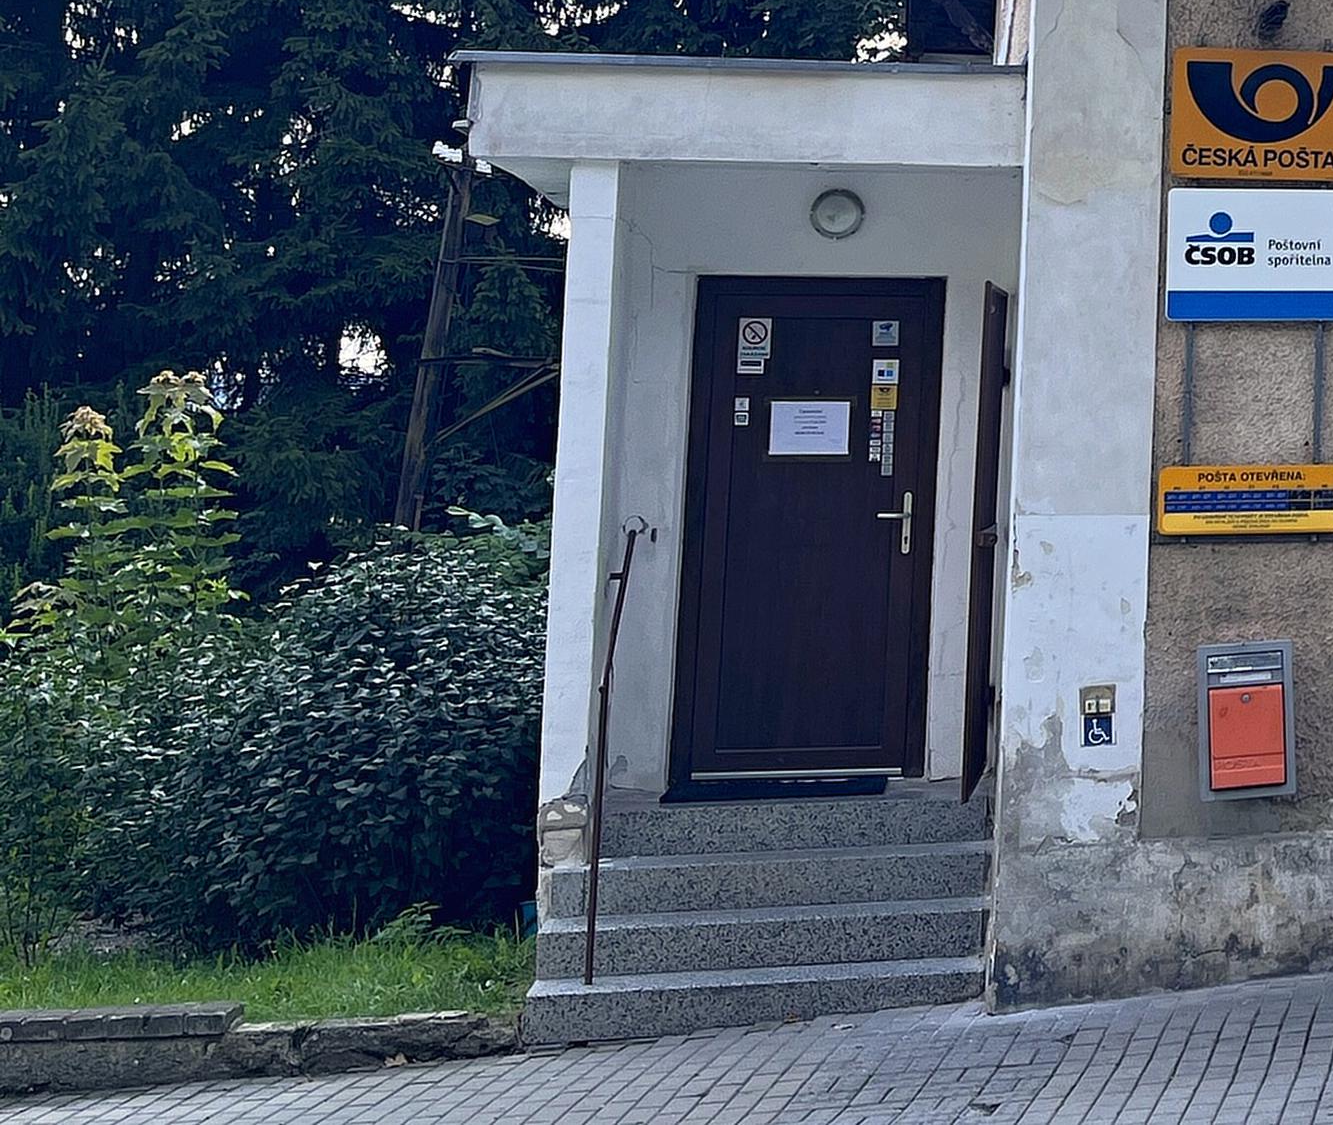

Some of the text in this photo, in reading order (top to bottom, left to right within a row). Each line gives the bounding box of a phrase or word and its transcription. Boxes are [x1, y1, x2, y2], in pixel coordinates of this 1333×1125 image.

[1181, 144, 1258, 167] ČESKÁ
[1267, 238, 1321, 251] Poštovní
[1184, 244, 1255, 266] ČSOB
[1267, 253, 1332, 268] spořitelna
[1198, 471, 1237, 483] POŠTA
